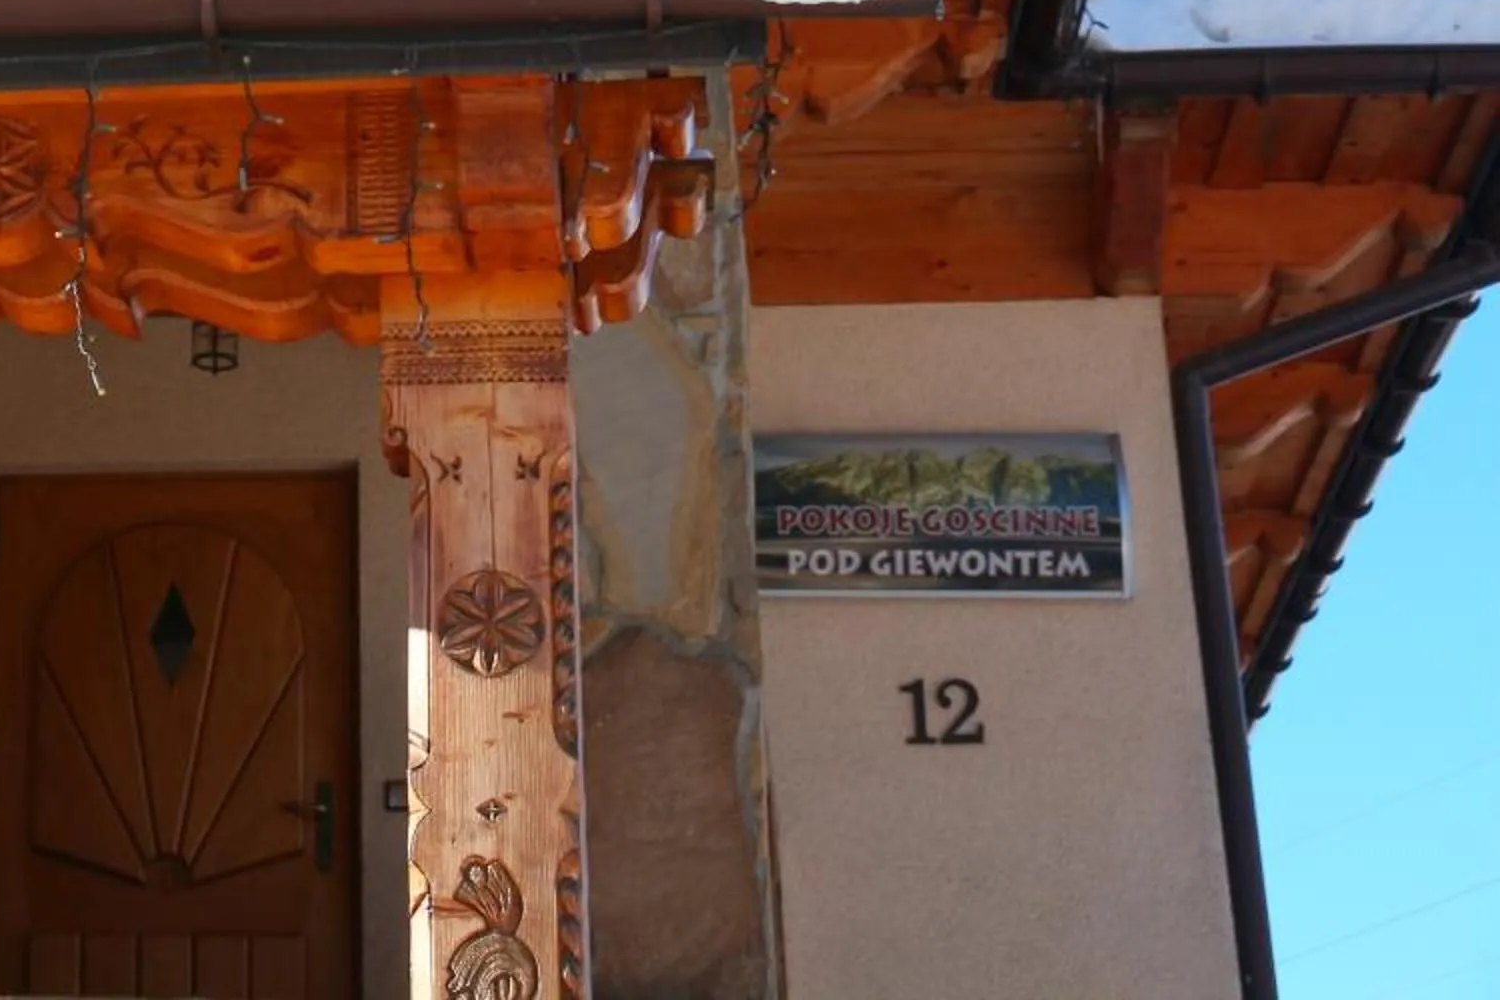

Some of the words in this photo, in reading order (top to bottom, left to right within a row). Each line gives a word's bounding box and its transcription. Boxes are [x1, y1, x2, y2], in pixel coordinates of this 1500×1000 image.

[777, 505, 911, 539] POKOJE
[787, 549, 861, 577] POD
[870, 549, 1091, 577] GIEWONTEM
[898, 678, 986, 745] 12
